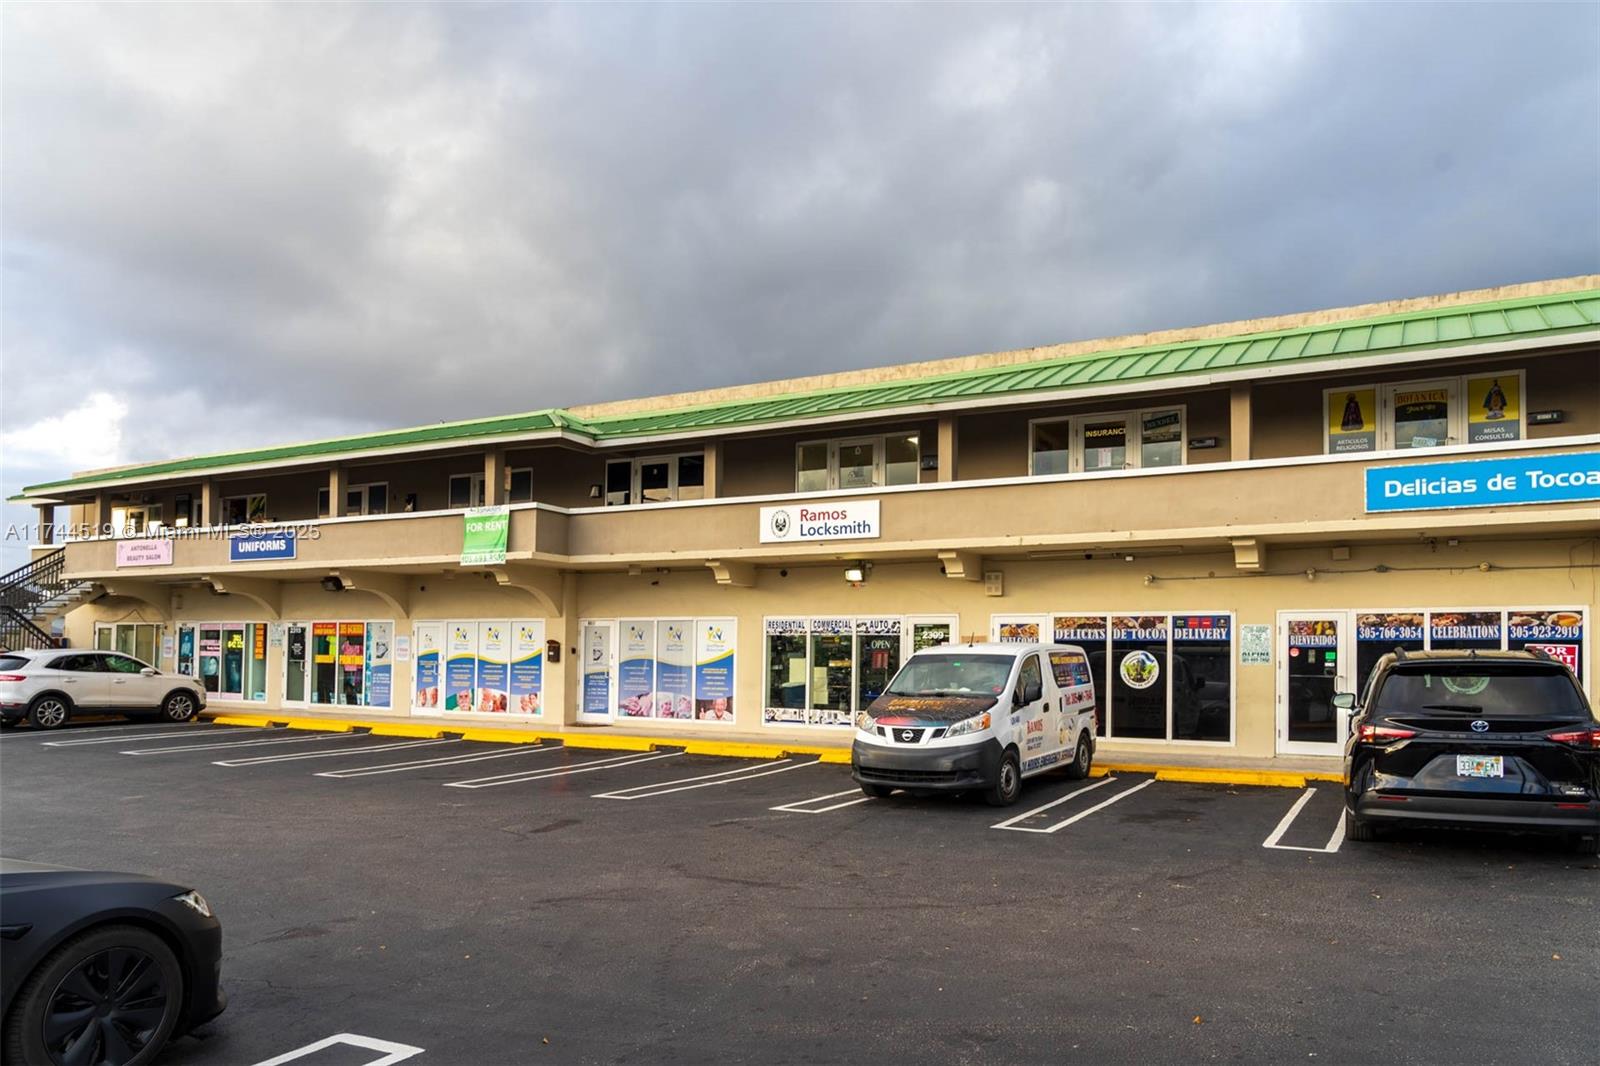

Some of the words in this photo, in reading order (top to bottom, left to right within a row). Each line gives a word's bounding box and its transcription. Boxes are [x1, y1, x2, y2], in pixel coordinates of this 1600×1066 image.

[1475, 432, 1514, 441] CONSULTAS
[1483, 427, 1505, 435] MISAS
[1384, 477, 1477, 498] Delicias
[1486, 473, 1517, 492] de
[1525, 470, 1600, 489] Tocoa
[800, 509, 847, 522] Ramos
[466, 522, 483, 533] FOR
[485, 520, 506, 532] RENT
[800, 520, 871, 537] Locksmith
[238, 539, 287, 553] UNIFORMS
[767, 620, 806, 630] RESIDENTIAL
[813, 619, 852, 629] COMMERCIAL
[869, 620, 889, 629] AUTO
[1055, 628, 1106, 640] DELICIAS
[1113, 628, 1128, 640] DE
[1128, 628, 1167, 640] TOCOA
[1173, 628, 1228, 640] DELIVERY
[1359, 626, 1423, 639] 305-766-3054
[1432, 625, 1500, 639] CELEBRATIONS
[1510, 625, 1580, 639] 305-923-2919
[871, 639, 891, 649] OPEN
[1289, 635, 1337, 646] BIENVENIDOS
